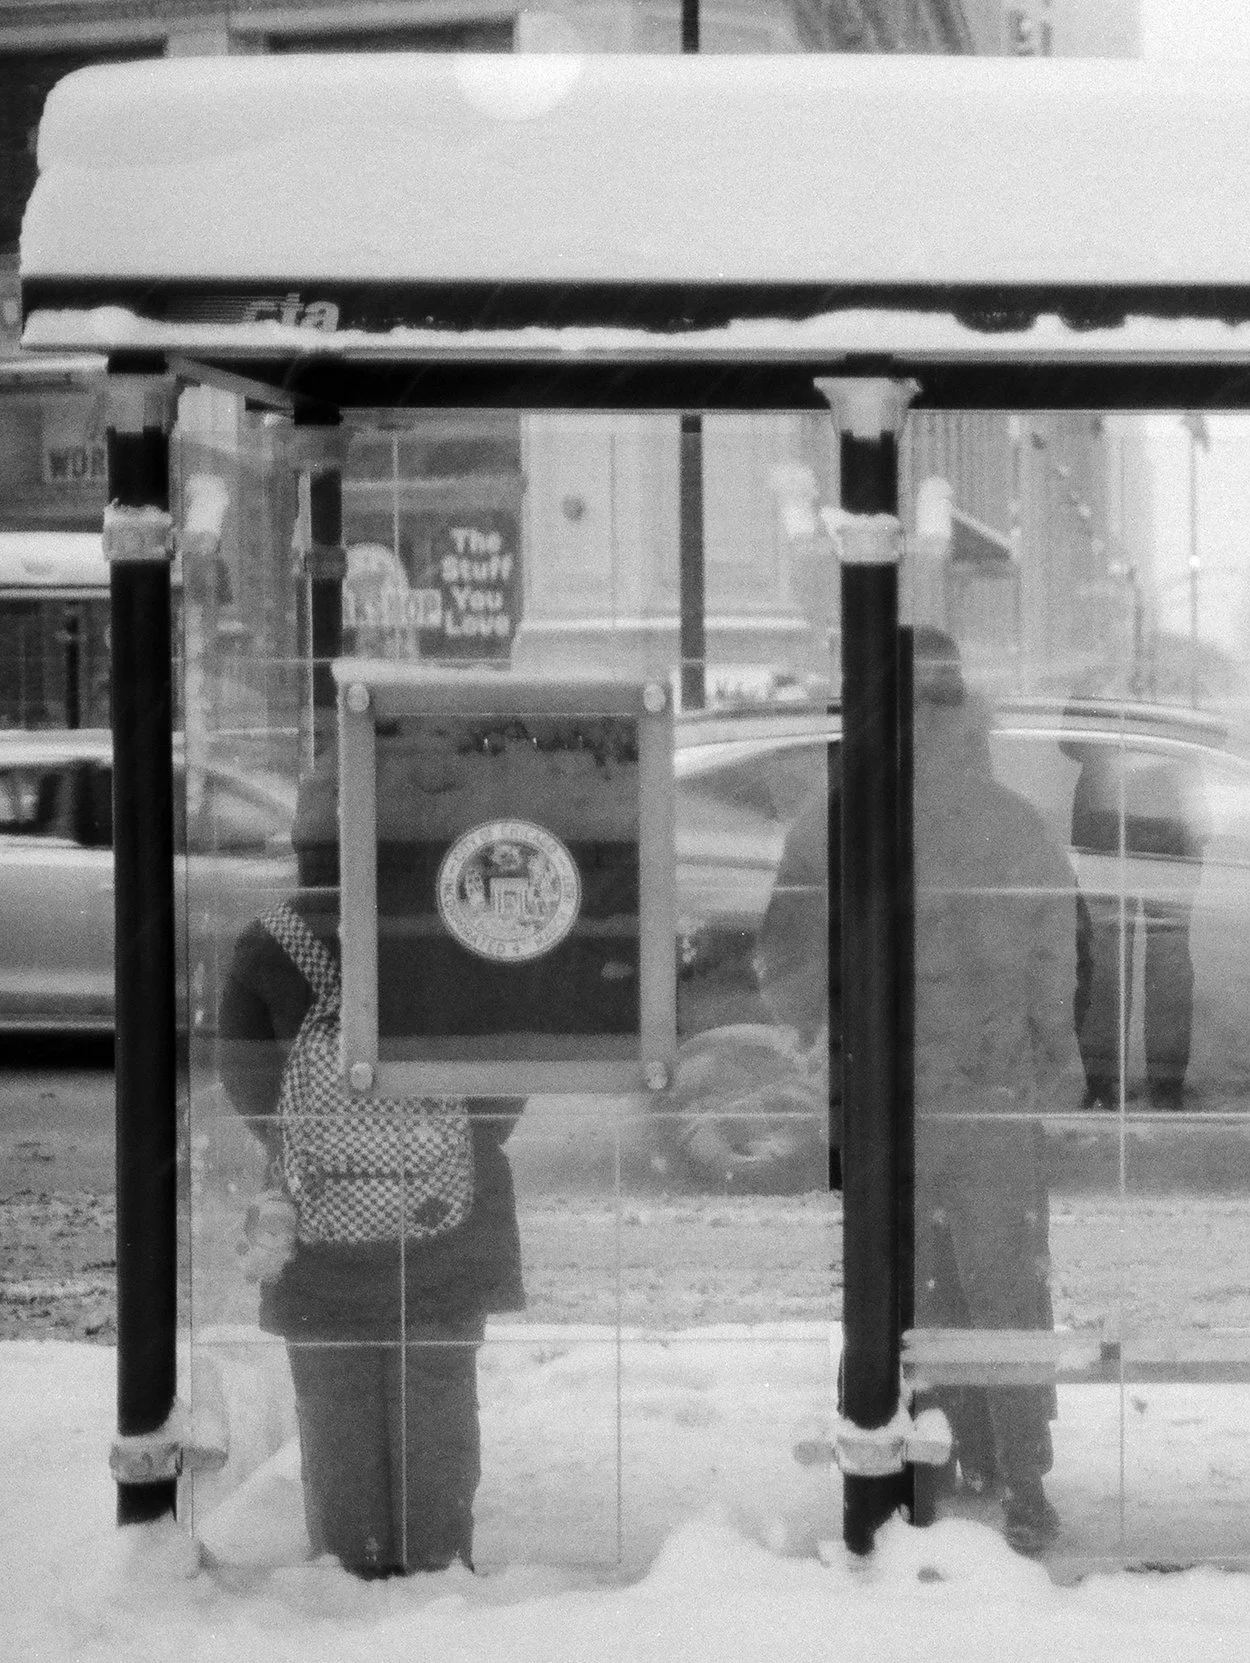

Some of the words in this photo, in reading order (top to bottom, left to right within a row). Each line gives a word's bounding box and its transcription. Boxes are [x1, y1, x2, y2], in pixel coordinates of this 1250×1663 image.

[451, 527, 502, 553] The
[441, 554, 513, 582] Stuff
[451, 585, 504, 611] You
[445, 611, 511, 637] Love
